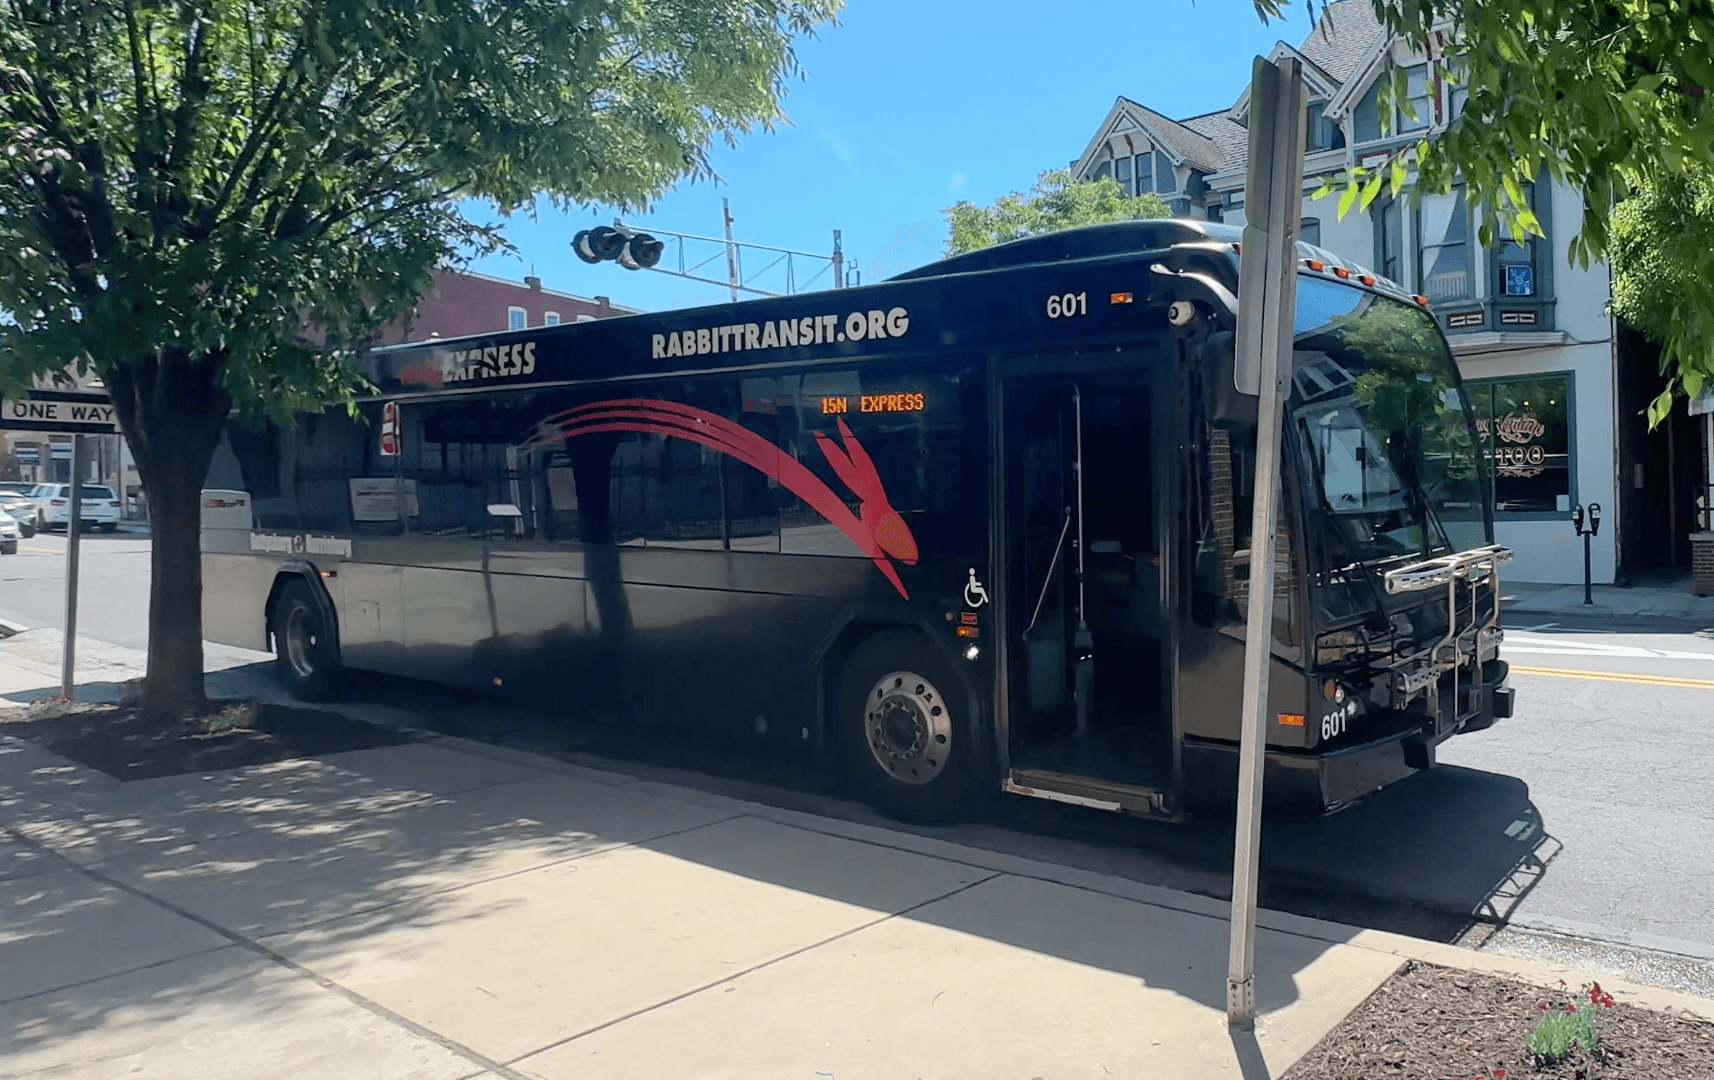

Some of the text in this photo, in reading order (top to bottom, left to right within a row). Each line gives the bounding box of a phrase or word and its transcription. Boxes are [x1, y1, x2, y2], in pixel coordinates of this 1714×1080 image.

[1047, 291, 1087, 318] 601
[652, 307, 909, 359] RABBITTRANSIT.ORG
[441, 342, 536, 383] EXPRESS
[13, 403, 113, 421] ONE WAY
[821, 393, 924, 414] 15N EXPRESS
[1322, 707, 1346, 740] 601
